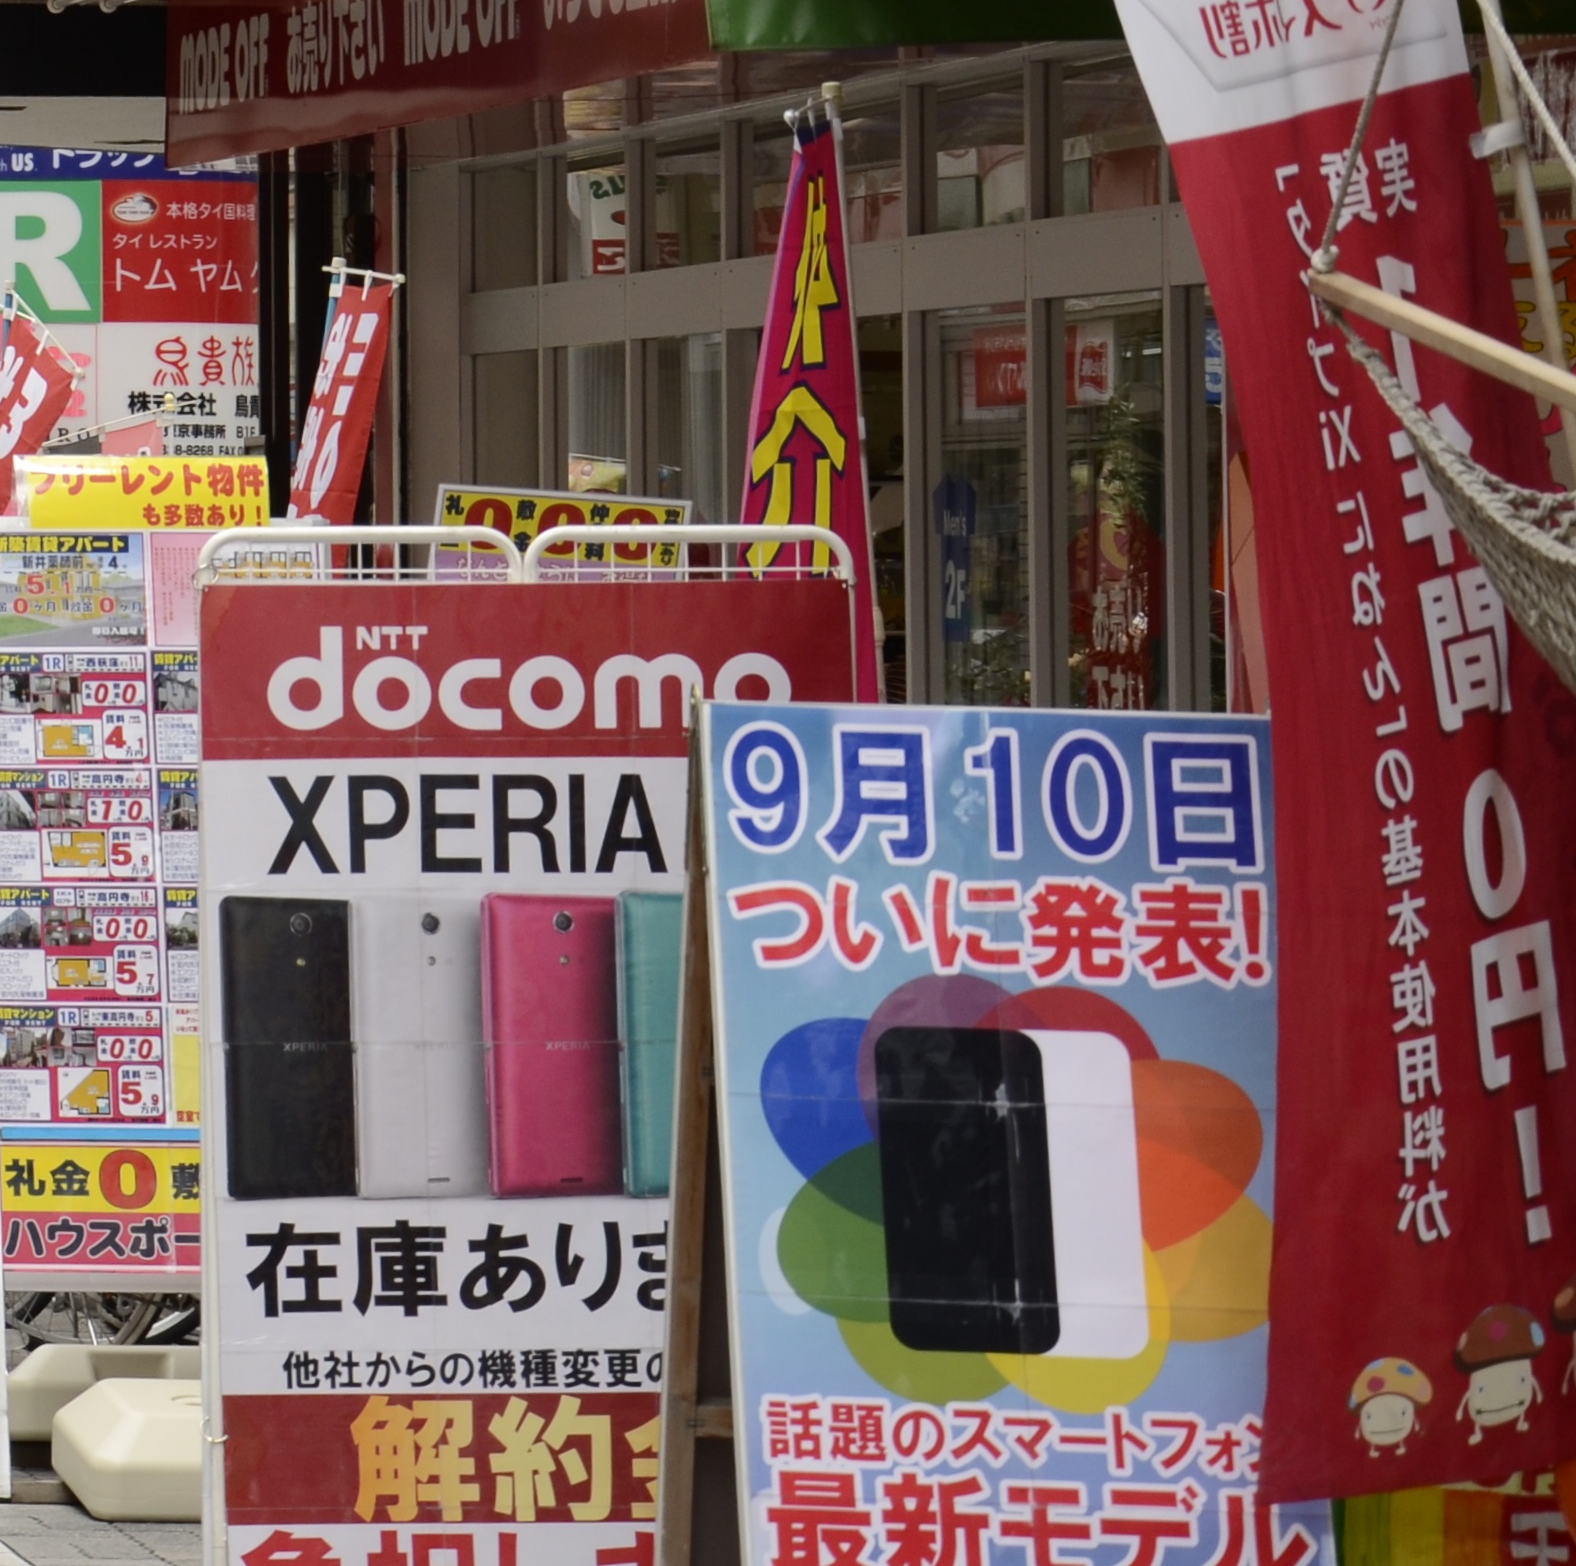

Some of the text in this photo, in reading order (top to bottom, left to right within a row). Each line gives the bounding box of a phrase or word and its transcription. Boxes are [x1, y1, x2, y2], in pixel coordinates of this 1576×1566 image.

[179, 13, 269, 115] MODE OFF
[128, 391, 217, 417] 株式会社
[30, 463, 265, 497] フリーレント物件
[356, 626, 428, 650] NTT
[44, 657, 63, 671] 1R
[267, 626, 791, 731] docomo
[50, 773, 67, 787] 1R
[726, 722, 1263, 872] 9月10日
[267, 774, 667, 874] XPERIA
[730, 876, 1273, 987] ついに発表!
[59, 1010, 77, 1024] 1R
